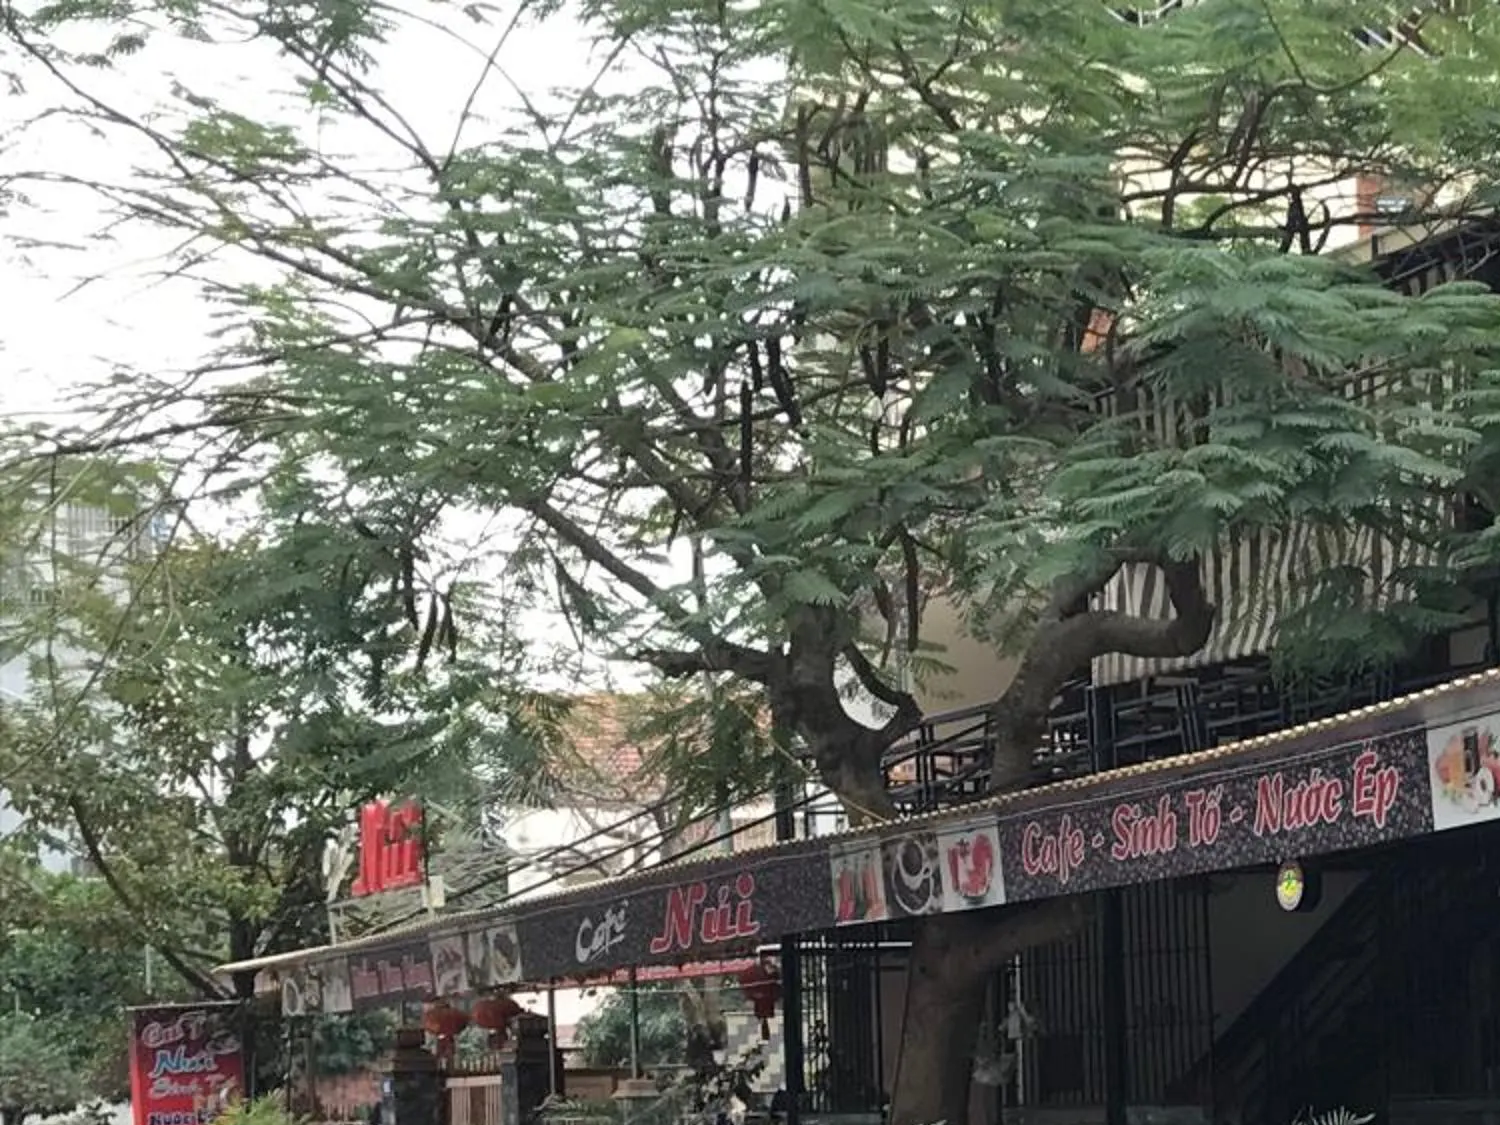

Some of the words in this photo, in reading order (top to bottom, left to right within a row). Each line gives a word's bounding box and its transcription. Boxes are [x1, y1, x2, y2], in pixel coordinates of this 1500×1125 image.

[1022, 814, 1085, 885] Cafe
[1112, 794, 1177, 860] Sinh
[1185, 784, 1224, 847] Tố
[1253, 768, 1343, 836] Nước
[1353, 739, 1399, 829] Ép
[650, 873, 761, 954] Núi
